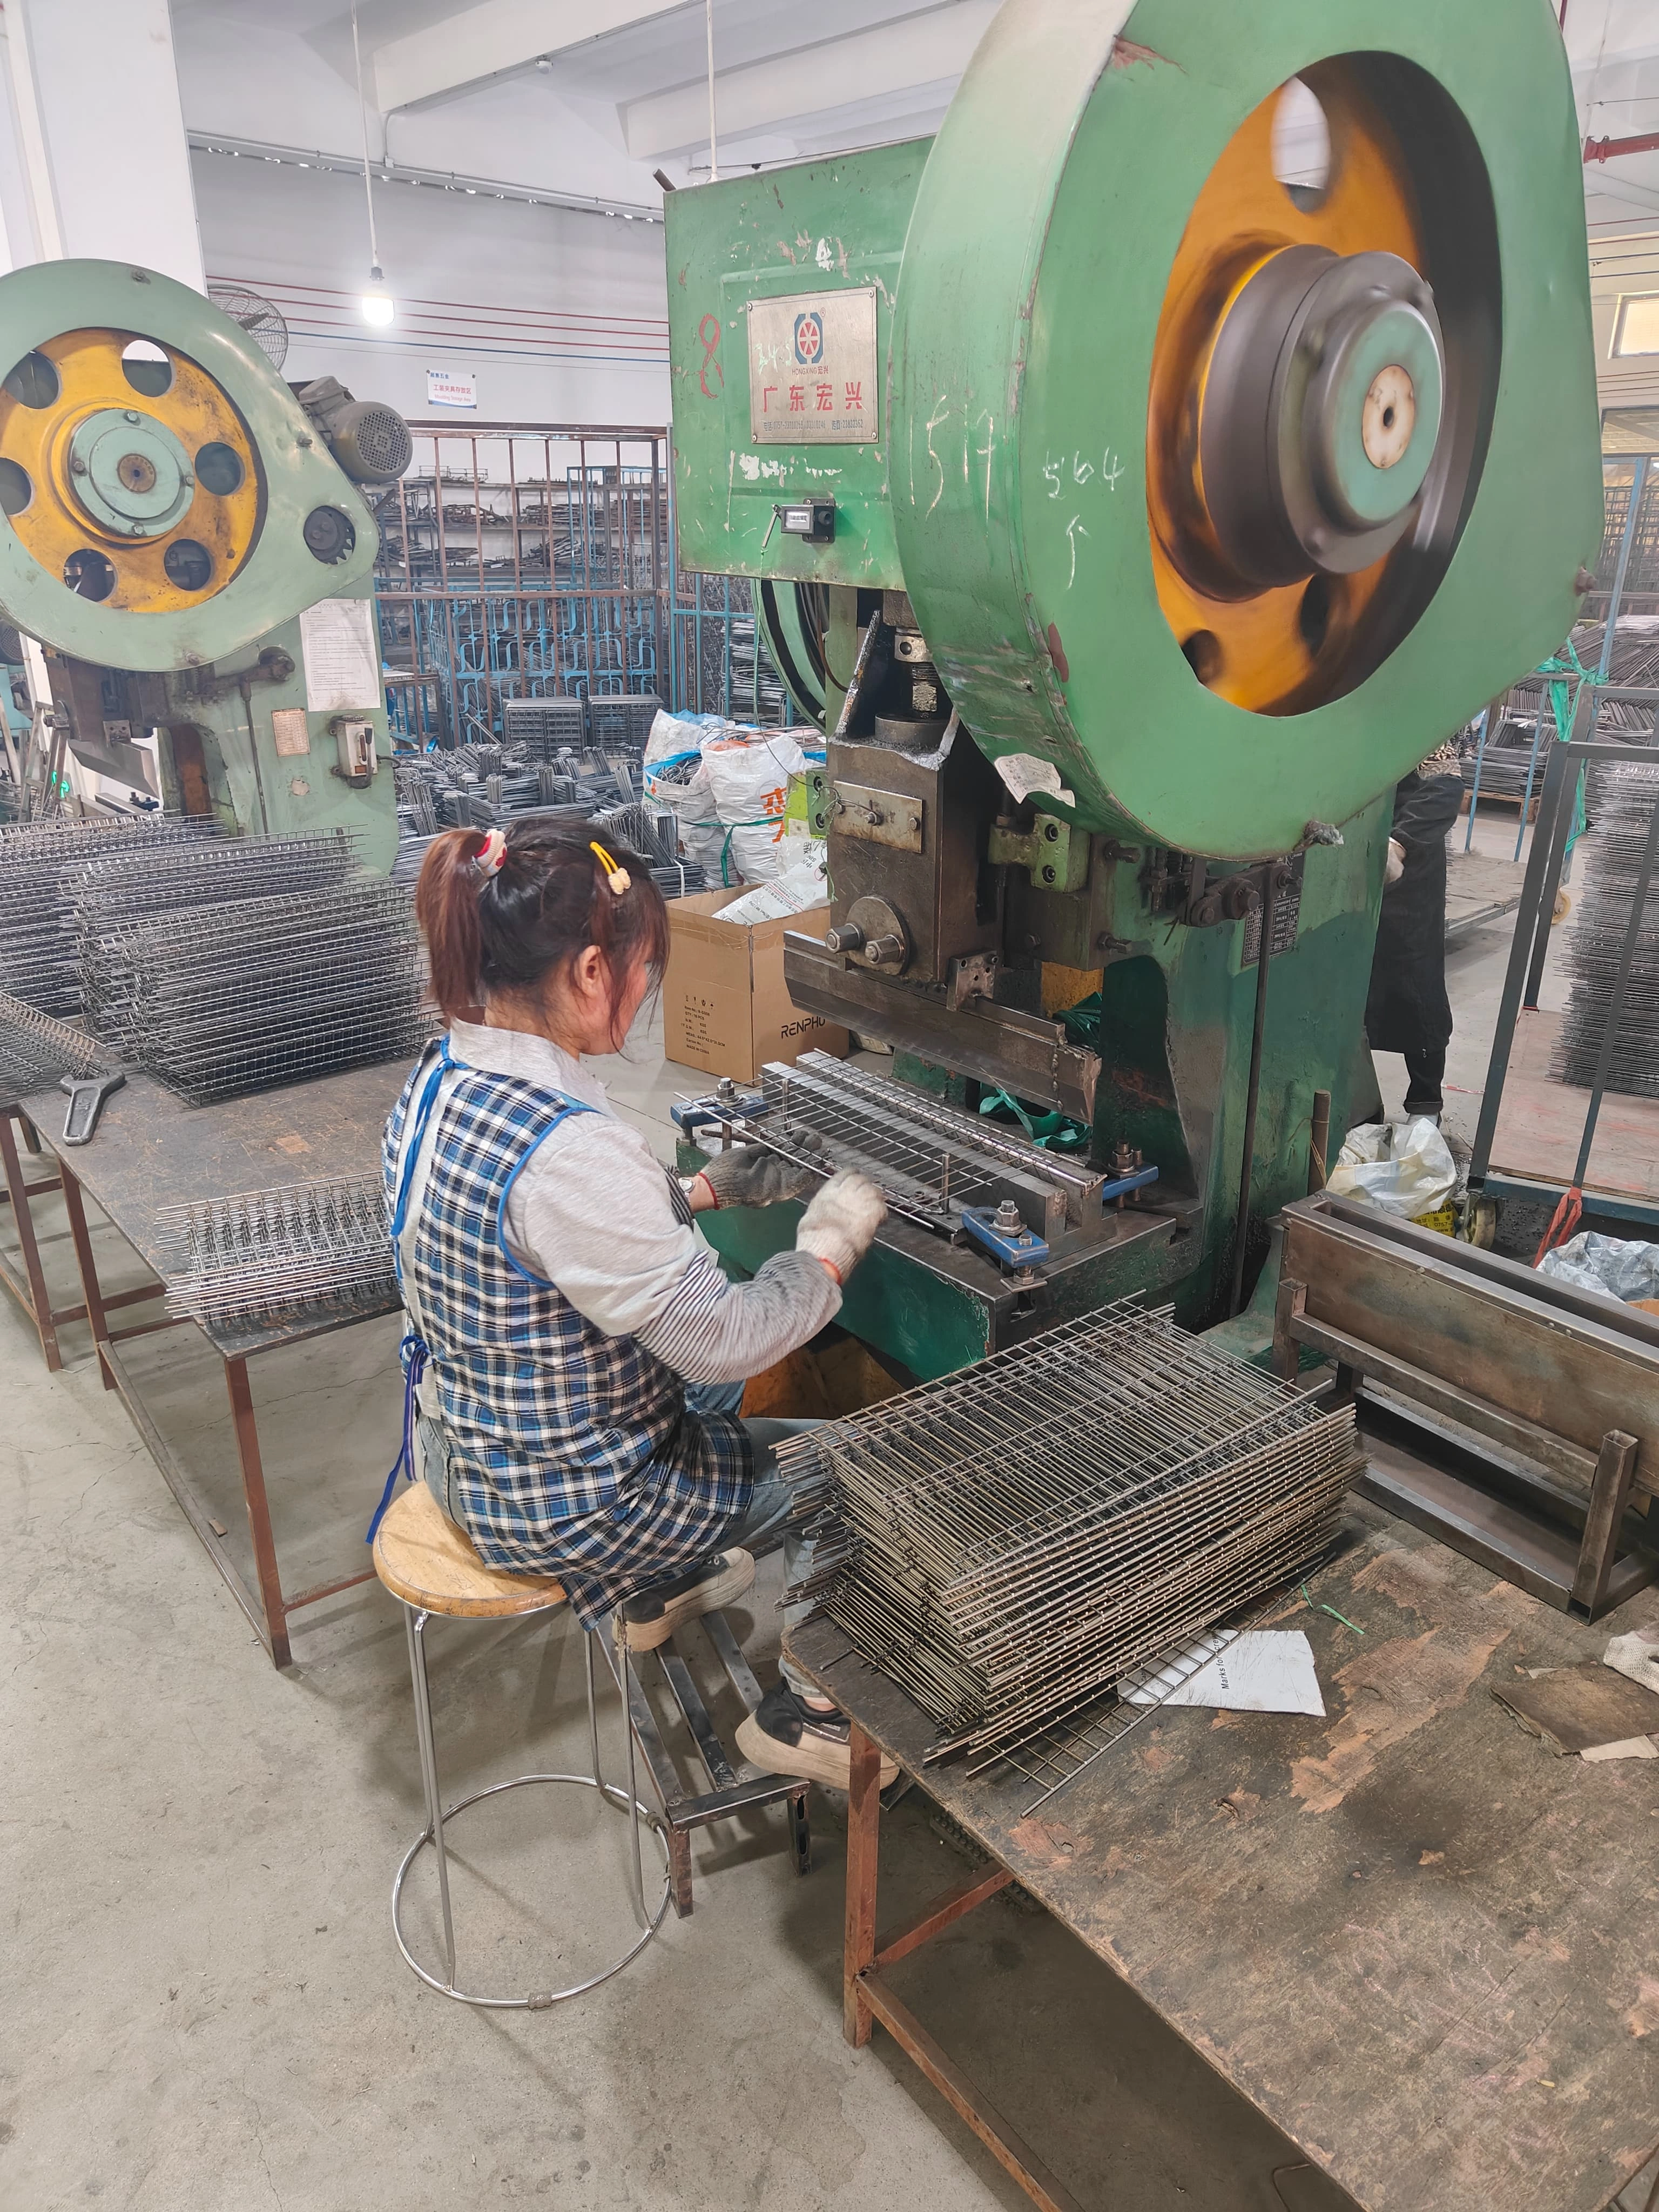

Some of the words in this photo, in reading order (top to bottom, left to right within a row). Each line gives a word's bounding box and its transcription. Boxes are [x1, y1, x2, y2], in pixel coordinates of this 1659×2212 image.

[763, 381, 862, 413] 广东宏兴
[1219, 1667, 1230, 1690] Marks
